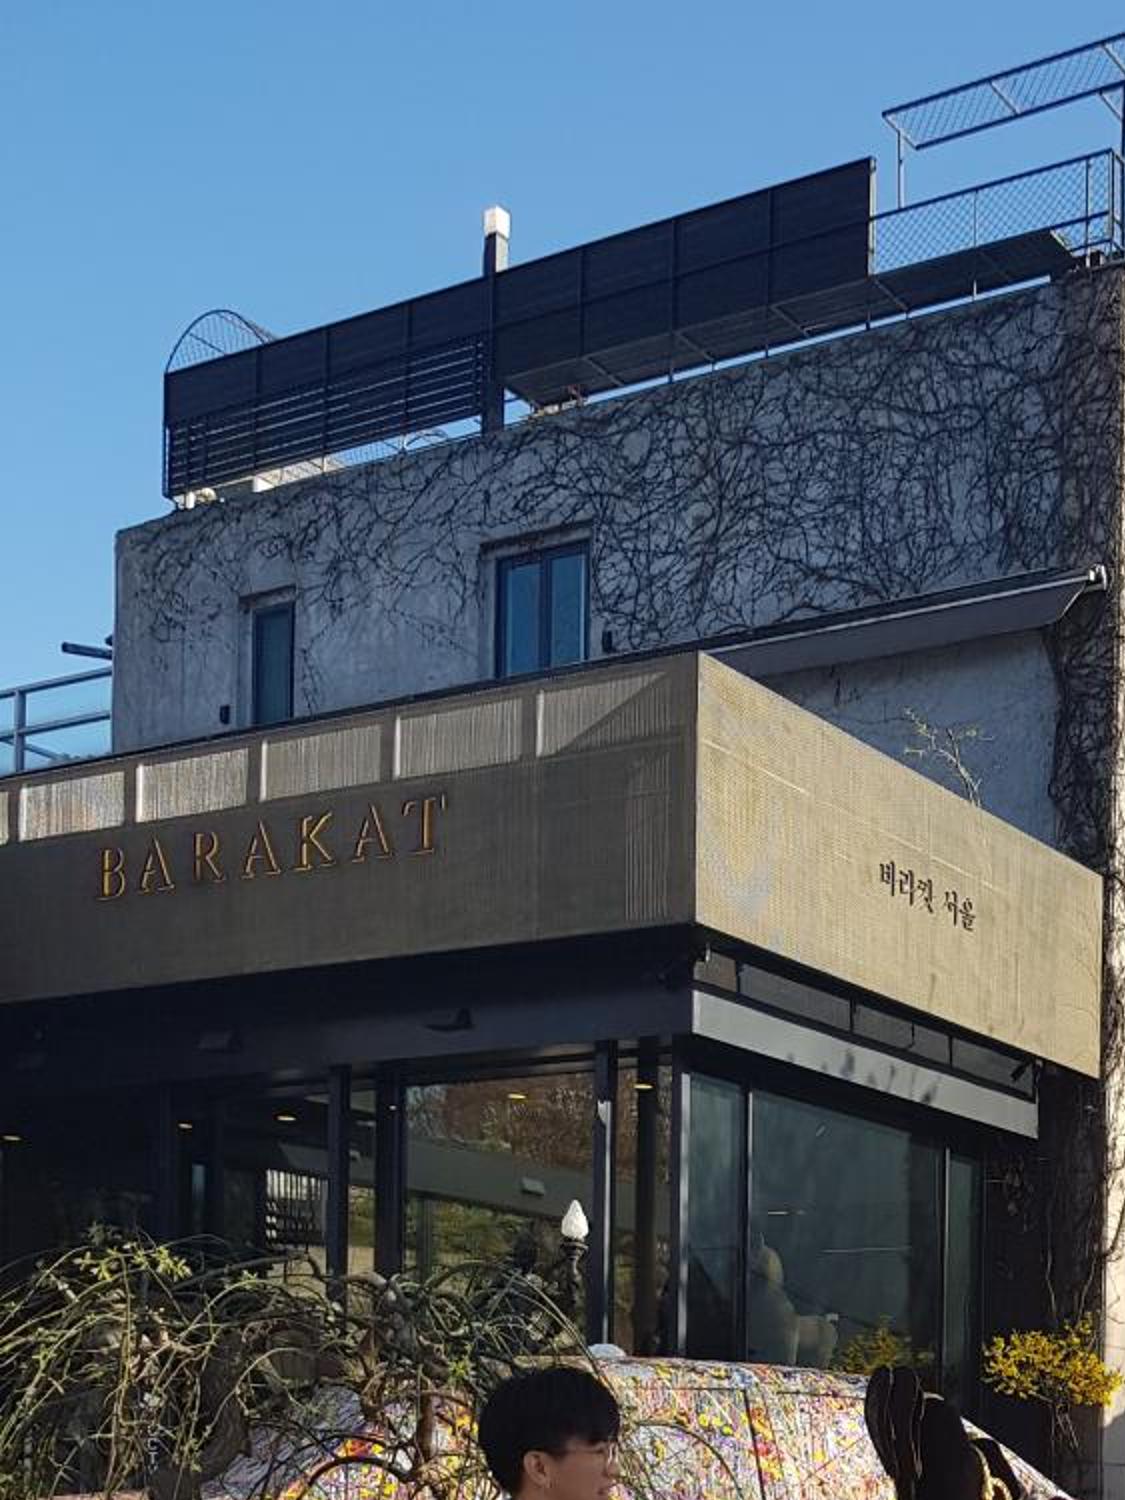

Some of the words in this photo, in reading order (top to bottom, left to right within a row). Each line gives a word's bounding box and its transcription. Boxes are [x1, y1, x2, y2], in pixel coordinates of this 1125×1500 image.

[96, 794, 446, 900] BARAKAT
[879, 860, 934, 914] 바라캇
[943, 890, 976, 932] 서울
